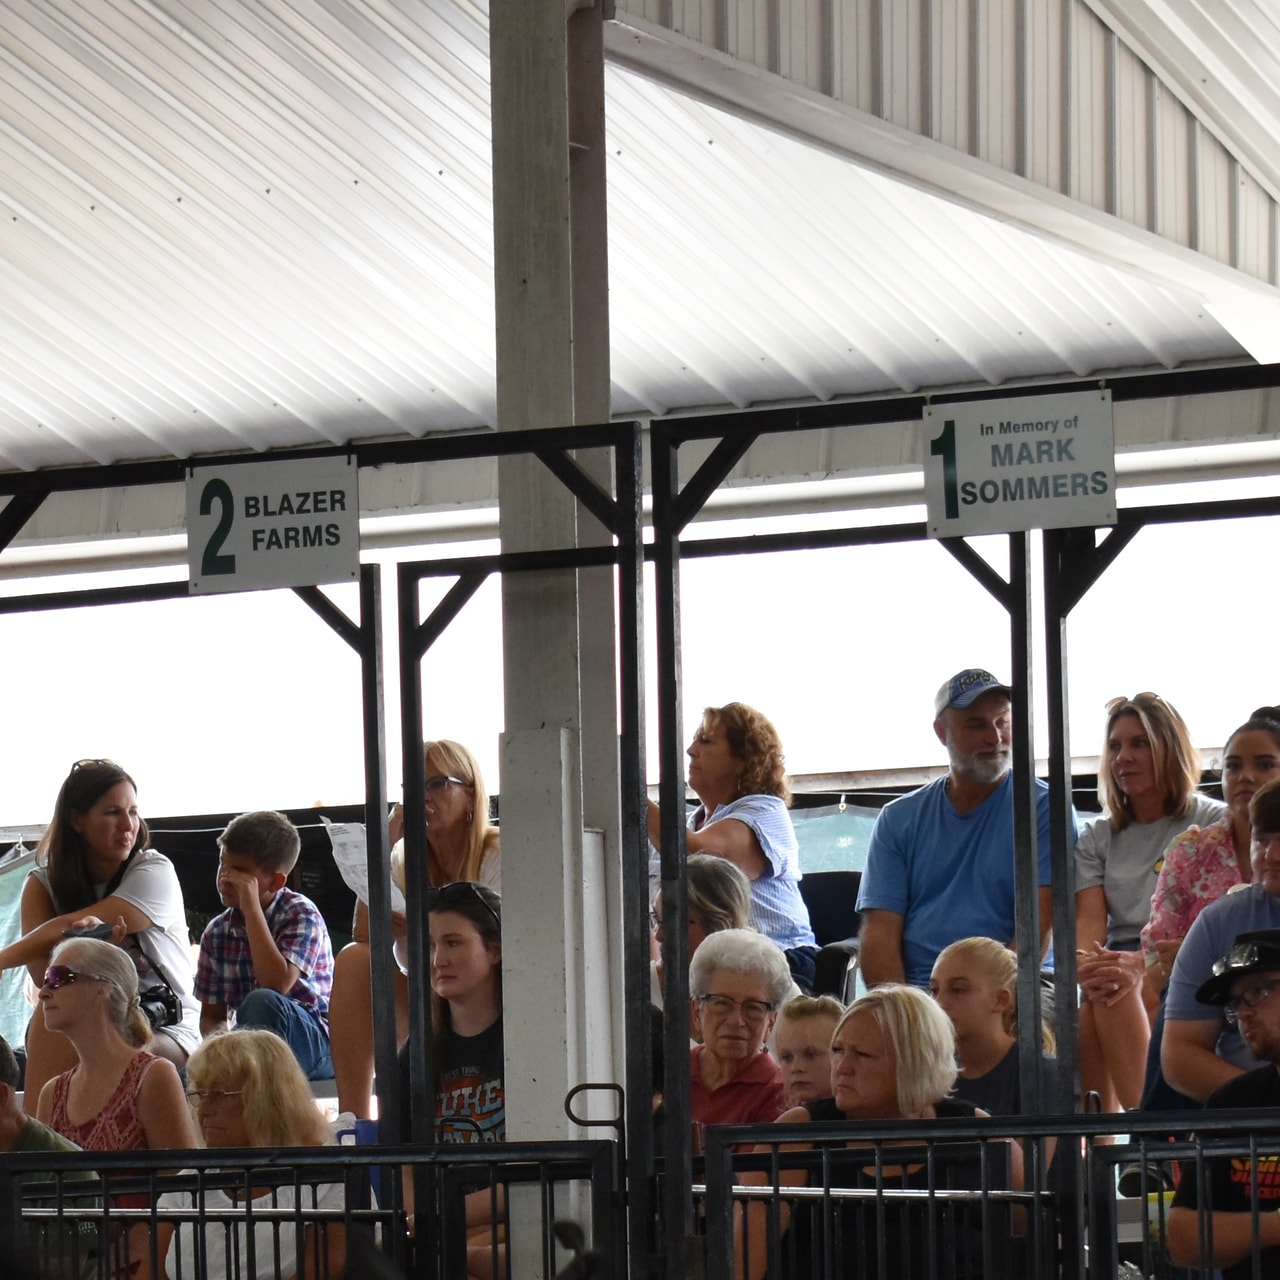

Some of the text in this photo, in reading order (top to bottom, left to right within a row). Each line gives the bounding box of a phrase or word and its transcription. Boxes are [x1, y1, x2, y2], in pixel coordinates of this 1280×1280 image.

[980, 416, 1078, 436] In Memory of
[991, 438, 1075, 467] MARK
[930, 420, 959, 519] 1
[960, 471, 1108, 505] SOMMERS
[245, 490, 346, 518] BLAZER
[199, 478, 236, 576] 2
[252, 523, 341, 551] FARMS
